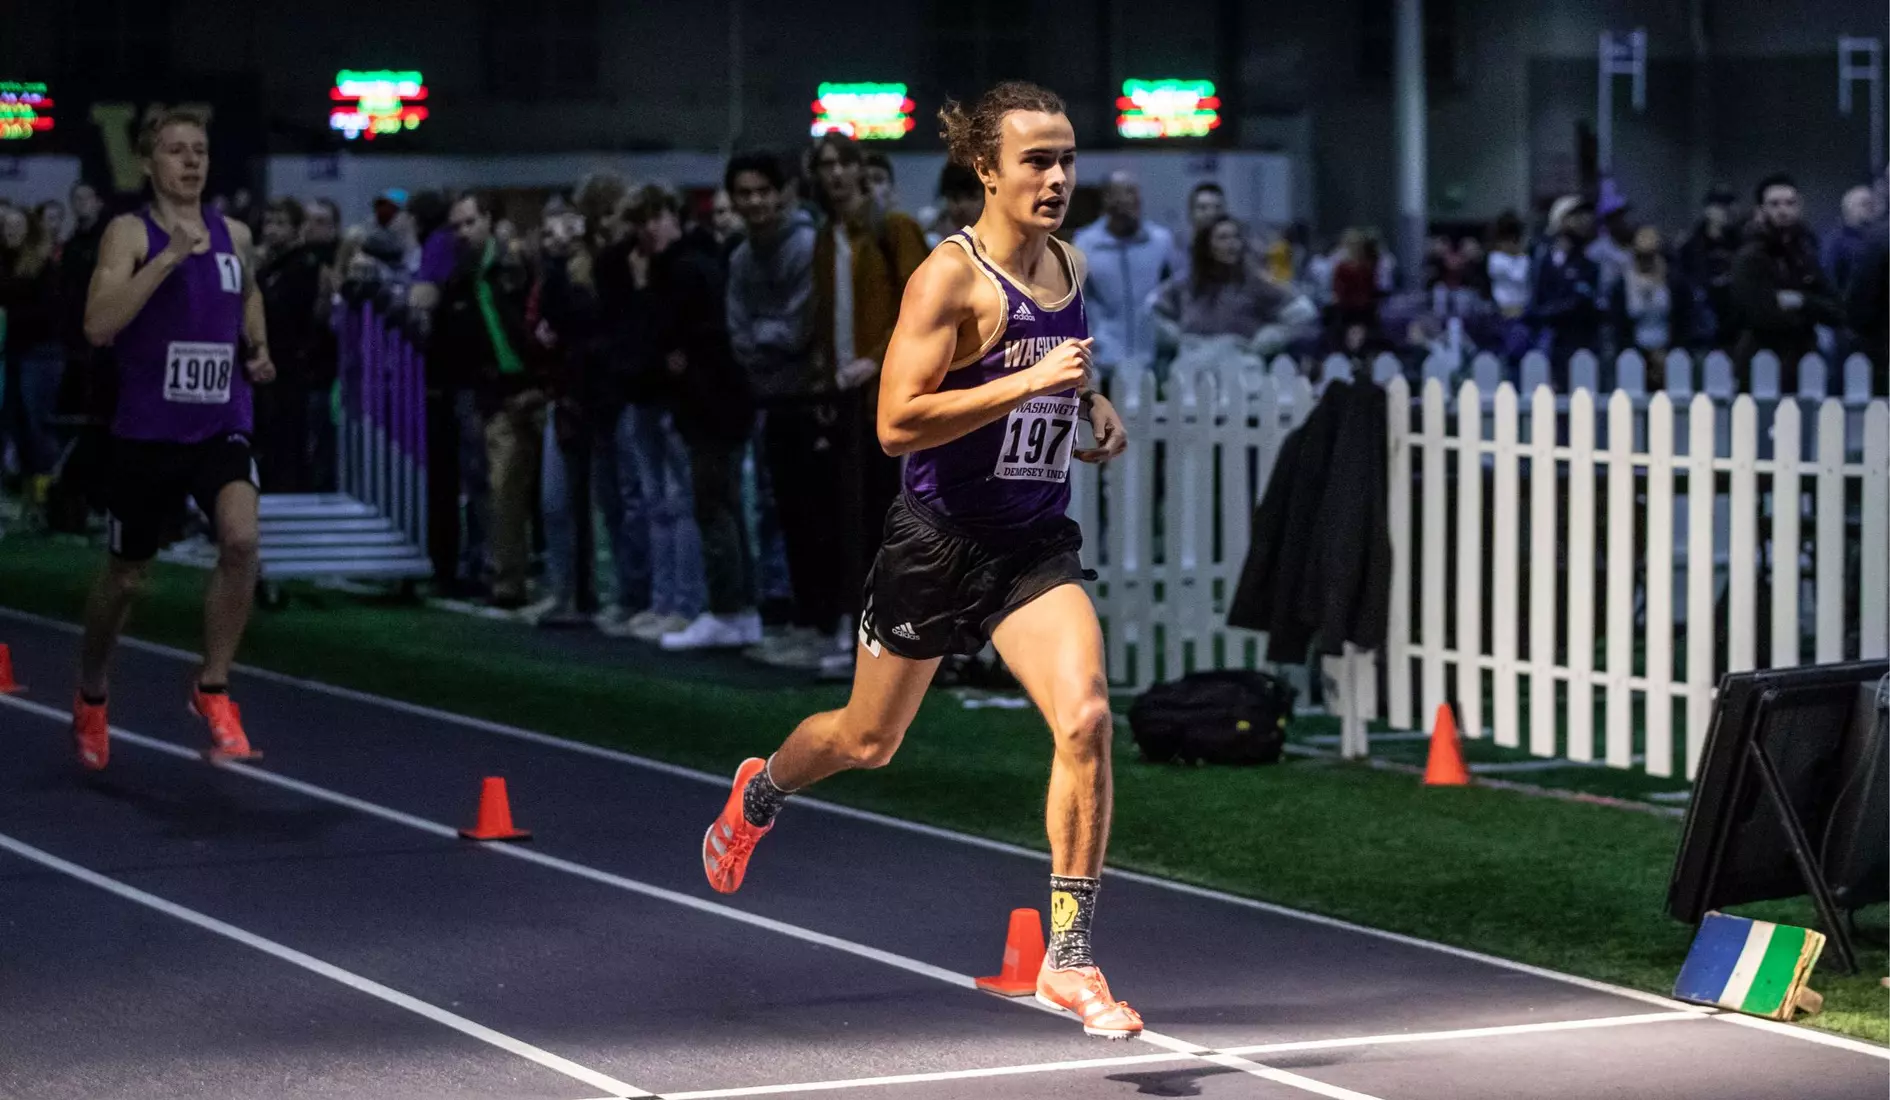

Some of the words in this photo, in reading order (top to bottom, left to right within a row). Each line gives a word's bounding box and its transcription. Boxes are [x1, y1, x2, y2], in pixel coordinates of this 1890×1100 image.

[224, 259, 237, 289] 1
[1013, 313, 1036, 322] adidas
[1004, 336, 1068, 368] WASH
[169, 358, 230, 391] 1908
[1016, 402, 1079, 416] WASHINGT
[1004, 466, 1045, 477] DEMPSEY
[892, 627, 921, 641] adidas
